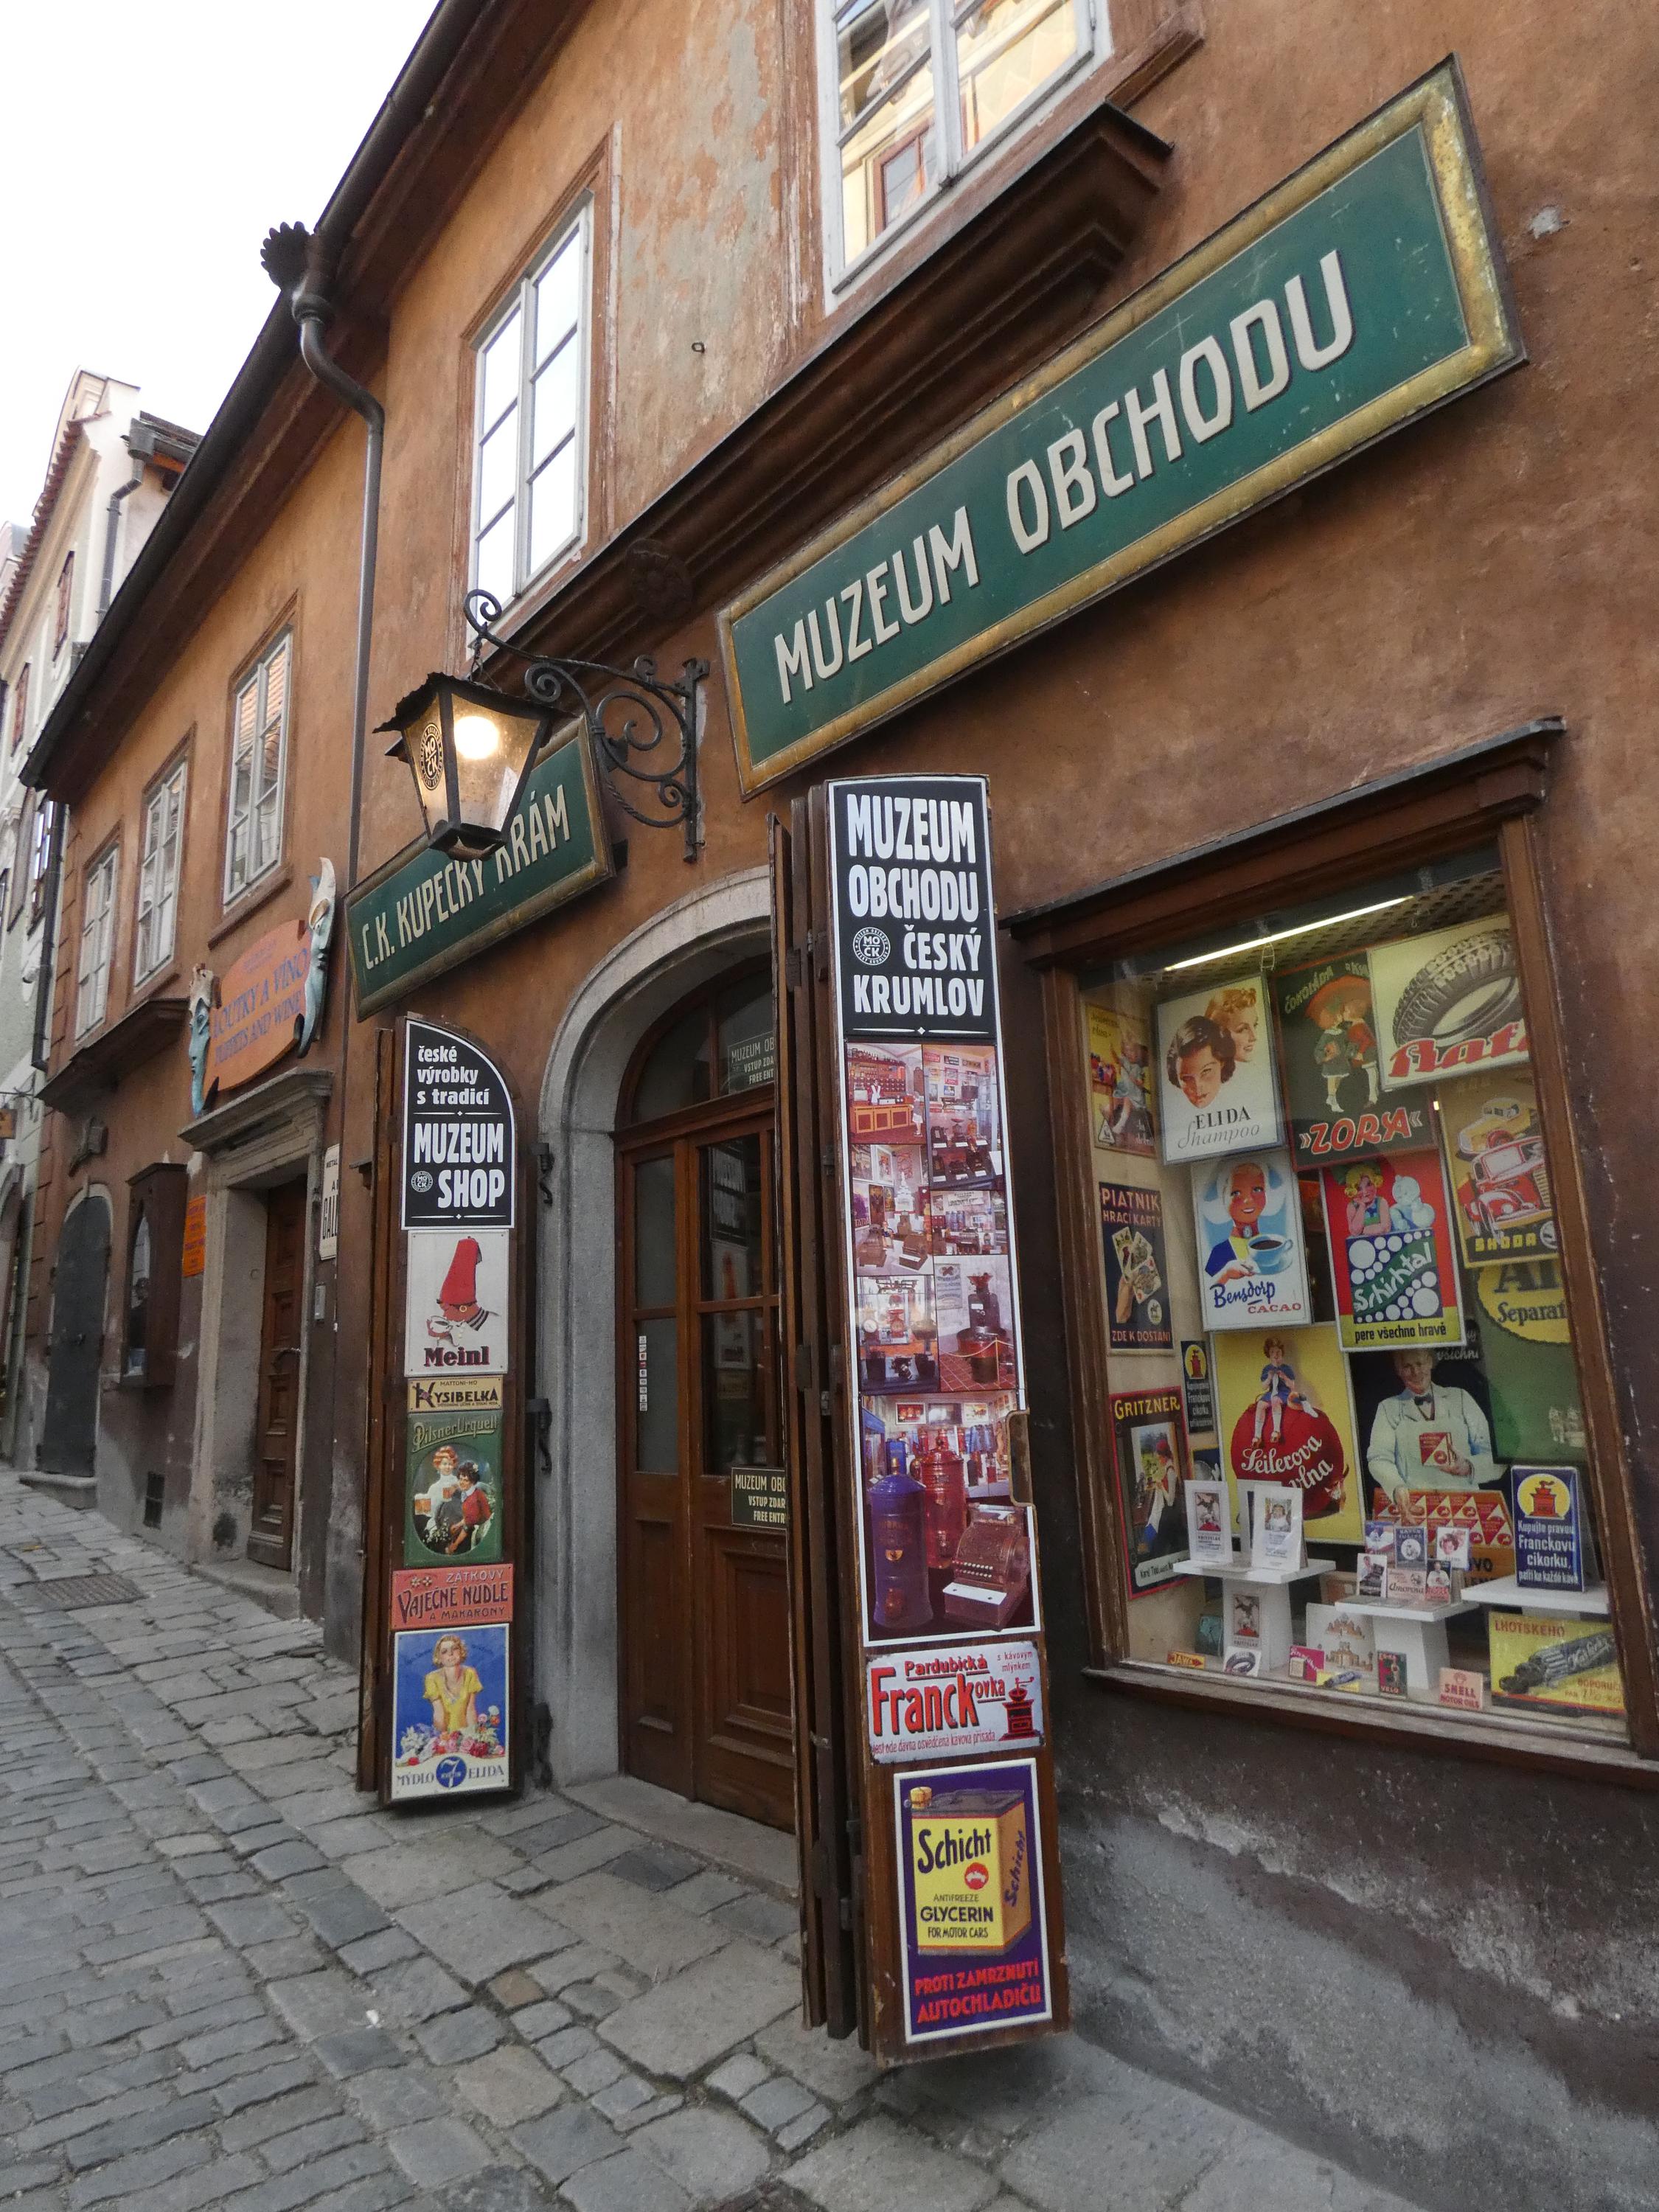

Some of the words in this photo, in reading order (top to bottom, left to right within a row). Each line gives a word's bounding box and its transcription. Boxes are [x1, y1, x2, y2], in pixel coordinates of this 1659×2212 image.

[772, 506, 980, 705] MUZEUM
[1005, 249, 1354, 556] OBCHODU
[846, 793, 976, 863] MUZEUM
[849, 864, 979, 922] OBCHODU
[362, 912, 395, 970] C.K.
[863, 936, 880, 945] MO
[904, 925, 981, 971] ČESKÝ
[853, 975, 984, 1016] KRUMLOV
[418, 1046, 457, 1062] české
[731, 1042, 761, 1064] MUZEUM
[417, 1066, 479, 1085] výrobky
[743, 1059, 762, 1073] VSTUP
[749, 1071, 762, 1085] FREE
[417, 1092, 425, 1105] s
[432, 1088, 490, 1105] tradicí
[1195, 1106, 1251, 1130] ELIDA
[414, 1123, 504, 1164] MUZEUM
[1178, 1118, 1261, 1150] Shampoo
[437, 1169, 505, 1208] SHOP
[1102, 1187, 1160, 1211] PIATNIK
[1133, 1213, 1161, 1228] KARTY
[1209, 1280, 1276, 1309] Bensdorp
[1247, 1302, 1302, 1315] CACAO
[1112, 1329, 1128, 1342] ZDE
[1129, 1331, 1135, 1342] K
[1354, 1328, 1375, 1344] pere
[1377, 1324, 1416, 1340] všechno
[1419, 1321, 1447, 1337] hravé
[423, 1346, 490, 1367] Meinl
[412, 1382, 498, 1409] KYSIBELKA
[413, 1423, 458, 1450] Pilsner
[457, 1415, 498, 1438] Urquell
[735, 1474, 767, 1491] MUZEUM
[1288, 1458, 1334, 1490] vlna
[748, 1495, 768, 1506] VSTUP
[754, 1510, 768, 1522] FREE
[1517, 1520, 1546, 1534] Kupujte
[1548, 1525, 1575, 1535] pravou
[1518, 1534, 1576, 1553] Franckovu
[463, 1582, 508, 1605] NUDLE
[429, 1613, 436, 1621] A
[441, 1606, 506, 1620] MAKARONY
[905, 1654, 988, 1677] Pardubická
[1440, 1694, 1464, 1705] MOTOR
[1444, 1683, 1475, 1699] SHELL
[468, 1764, 505, 1780] ELIDA
[917, 1829, 992, 1874] Schicht
[1004, 1830, 1026, 1907] Schicht
[933, 1893, 979, 1902] ANTIFREEZE
[920, 1906, 994, 1923] GLYCERIN
[928, 1927, 942, 1938] FOR
[942, 1926, 967, 1938] MOTOR
[969, 1926, 989, 1938] CARS
[914, 1974, 955, 1997] PROTI
